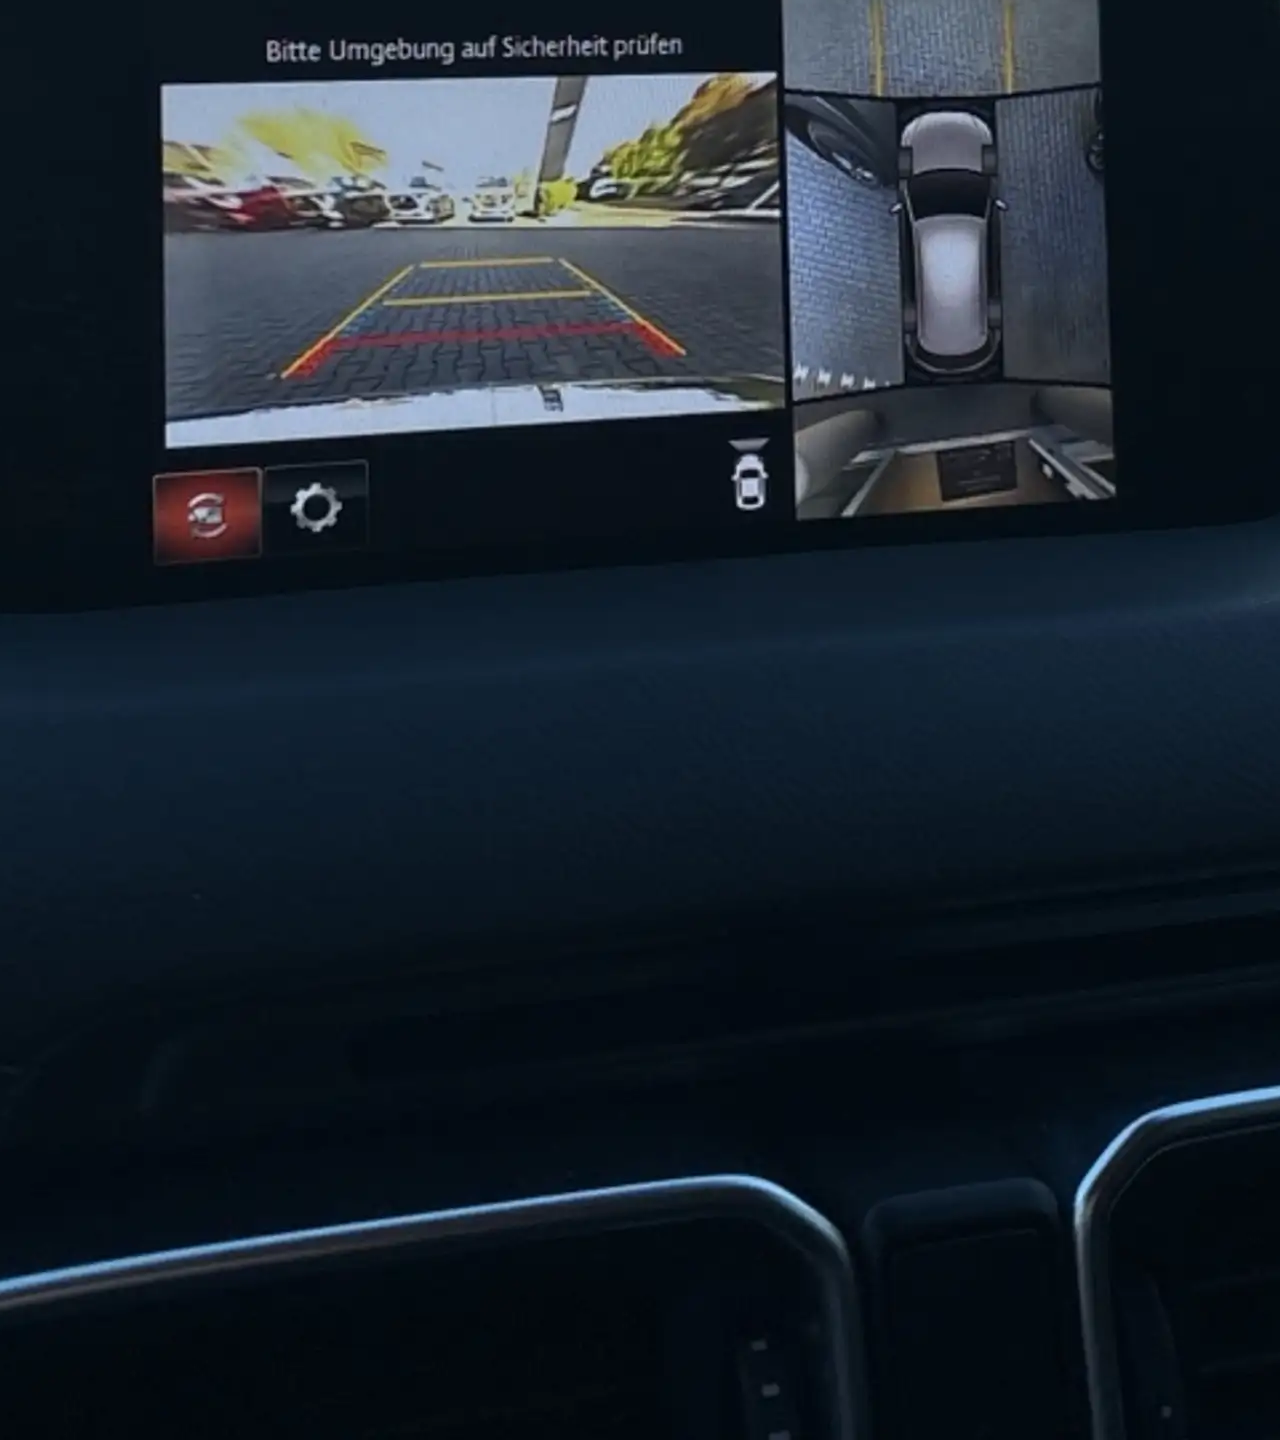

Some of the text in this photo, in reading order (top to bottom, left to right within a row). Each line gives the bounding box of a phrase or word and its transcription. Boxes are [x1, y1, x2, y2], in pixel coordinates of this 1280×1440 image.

[266, 32, 683, 66] Bitte Umgebung auf Sicherheit prüfen
